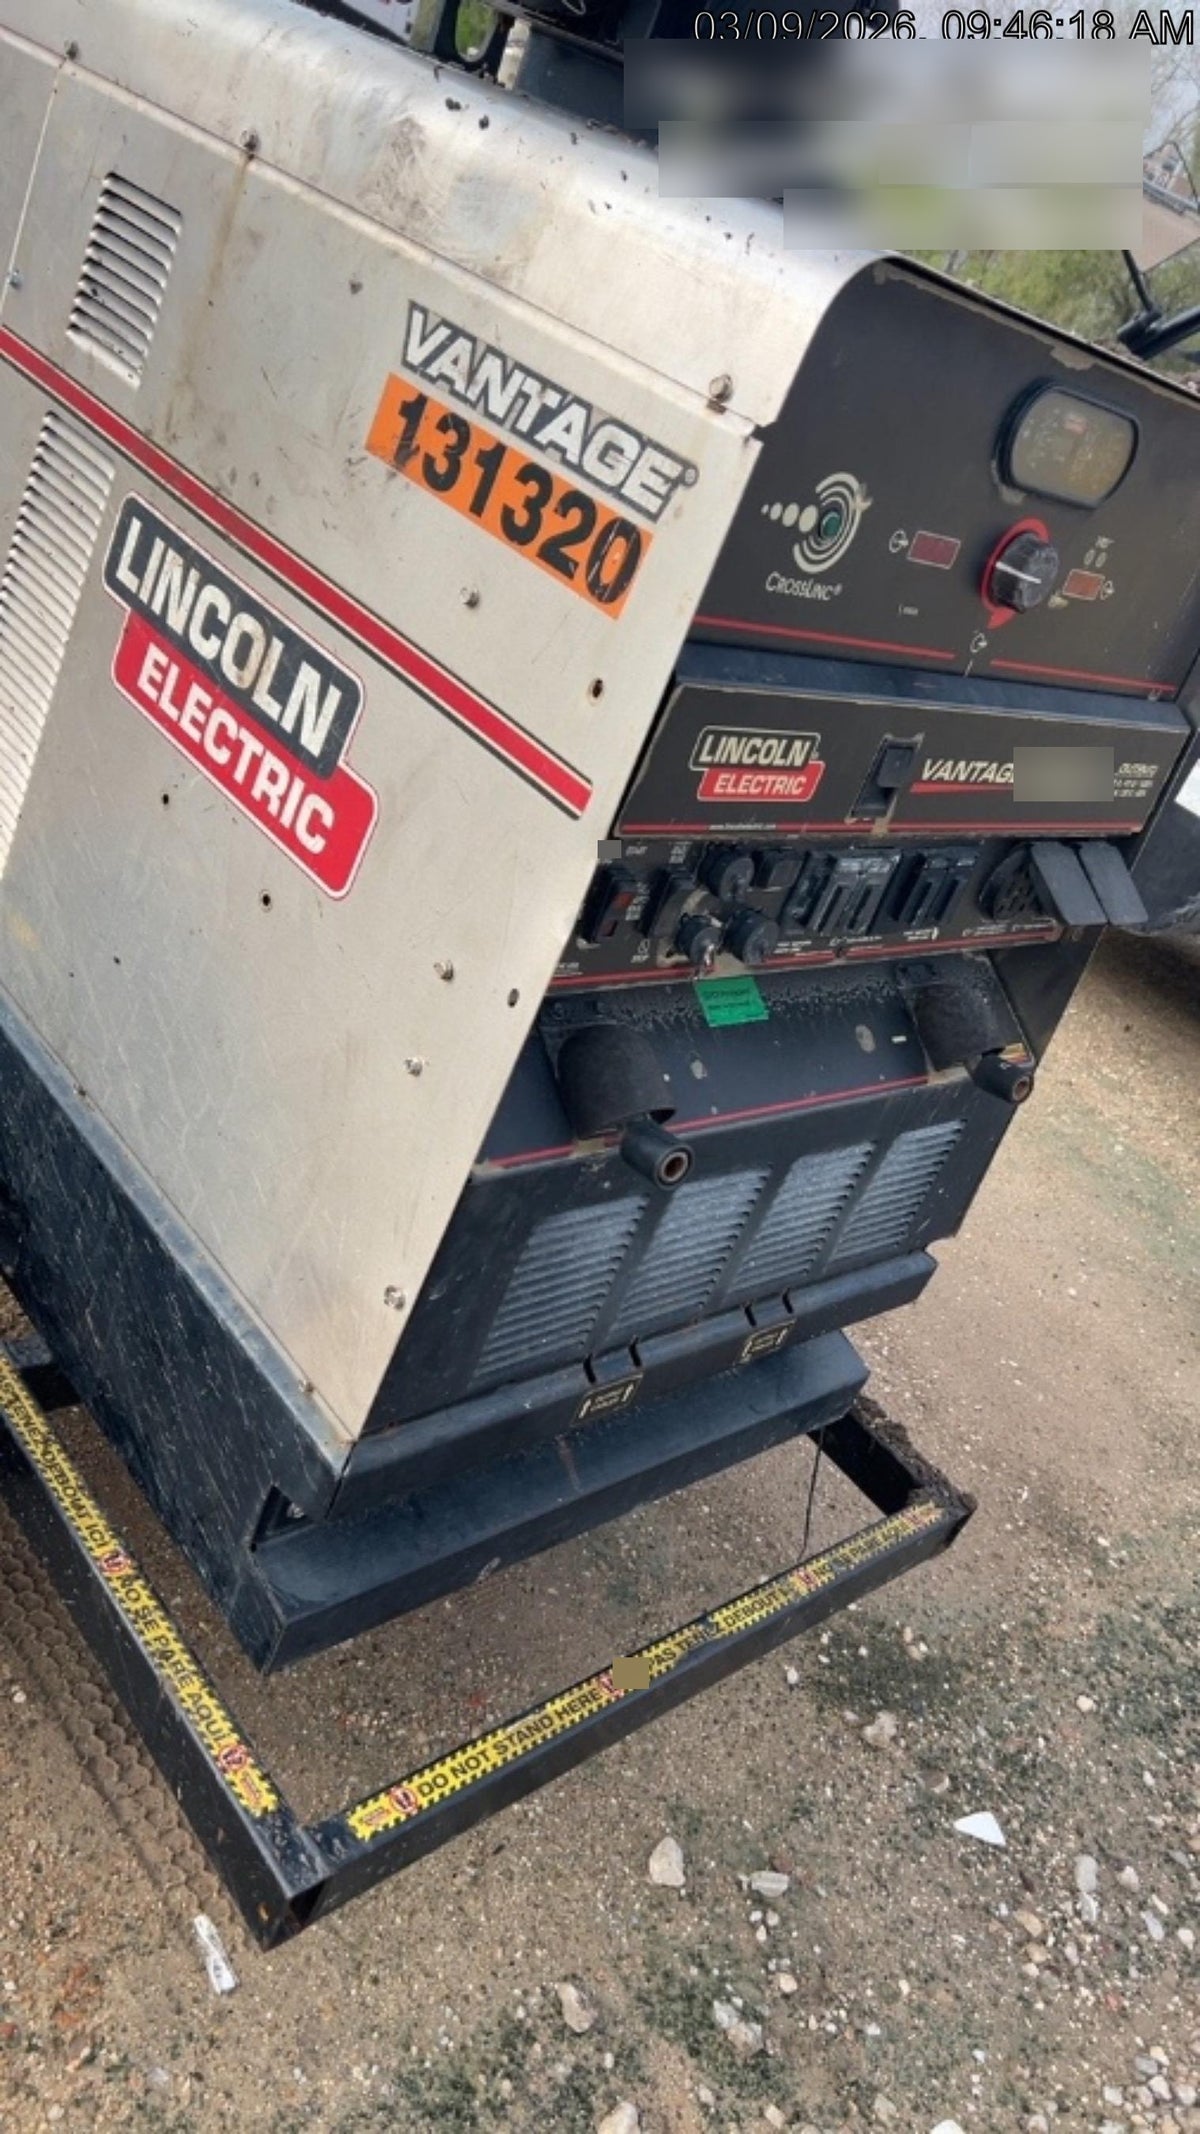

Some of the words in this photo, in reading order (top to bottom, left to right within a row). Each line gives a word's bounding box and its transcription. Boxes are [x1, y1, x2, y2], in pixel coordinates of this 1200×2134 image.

[394, 391, 643, 604] 131320
[115, 516, 342, 759] LINCOLN
[137, 642, 334, 856] ELECTRIC
[699, 734, 811, 767] LINCOLN
[713, 773, 807, 796] ELECTRIC
[920, 758, 1014, 783] VANTAG
[135, 1605, 160, 1632] SE
[152, 1635, 197, 1689] PARE
[722, 1592, 782, 1629] DEBOUT
[416, 1772, 450, 1798] DO
[450, 1749, 491, 1780] NOT
[496, 1715, 553, 1756] STAND
[553, 1688, 603, 1721] HERE
